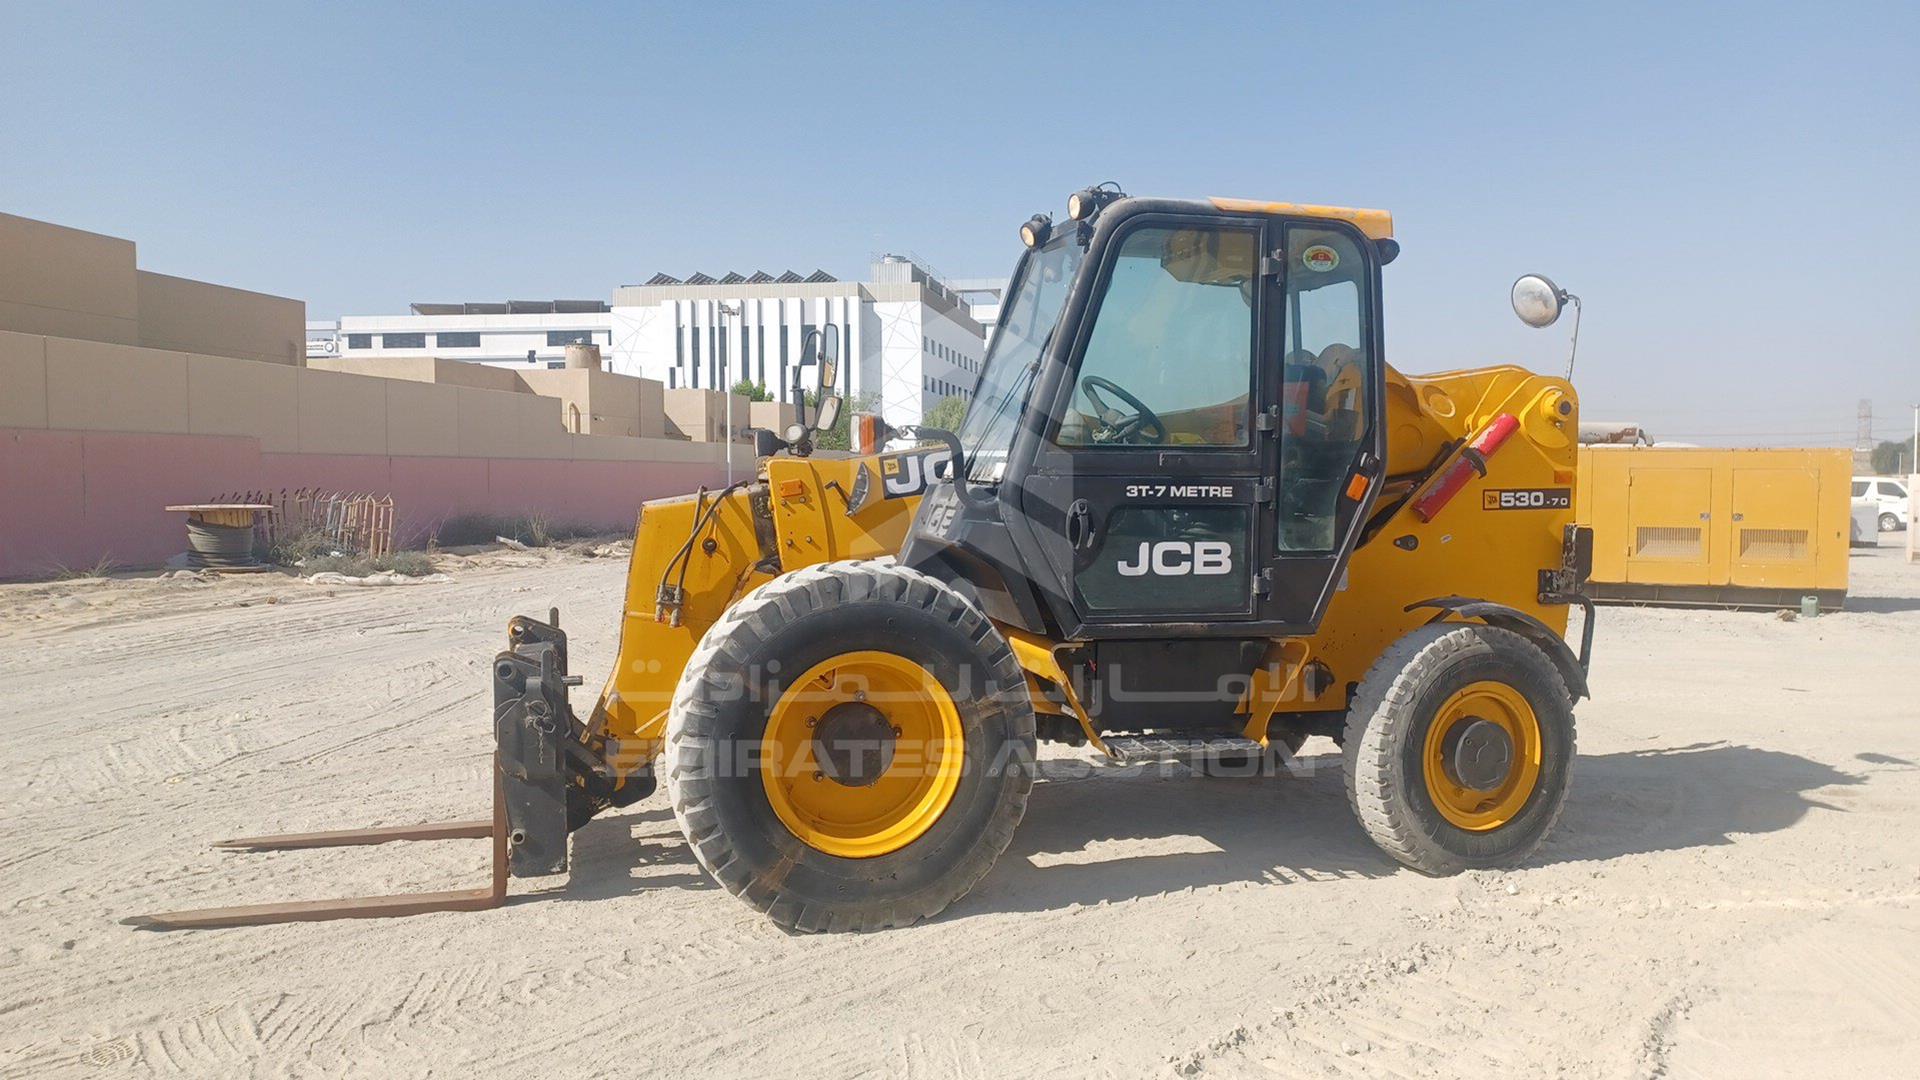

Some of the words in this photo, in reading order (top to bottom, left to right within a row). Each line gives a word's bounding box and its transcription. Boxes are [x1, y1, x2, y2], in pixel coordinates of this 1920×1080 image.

[886, 451, 952, 494] JC
[1126, 485, 1166, 498] 3T-7
[1170, 486, 1233, 498] METRE
[1117, 541, 1232, 576] JCB
